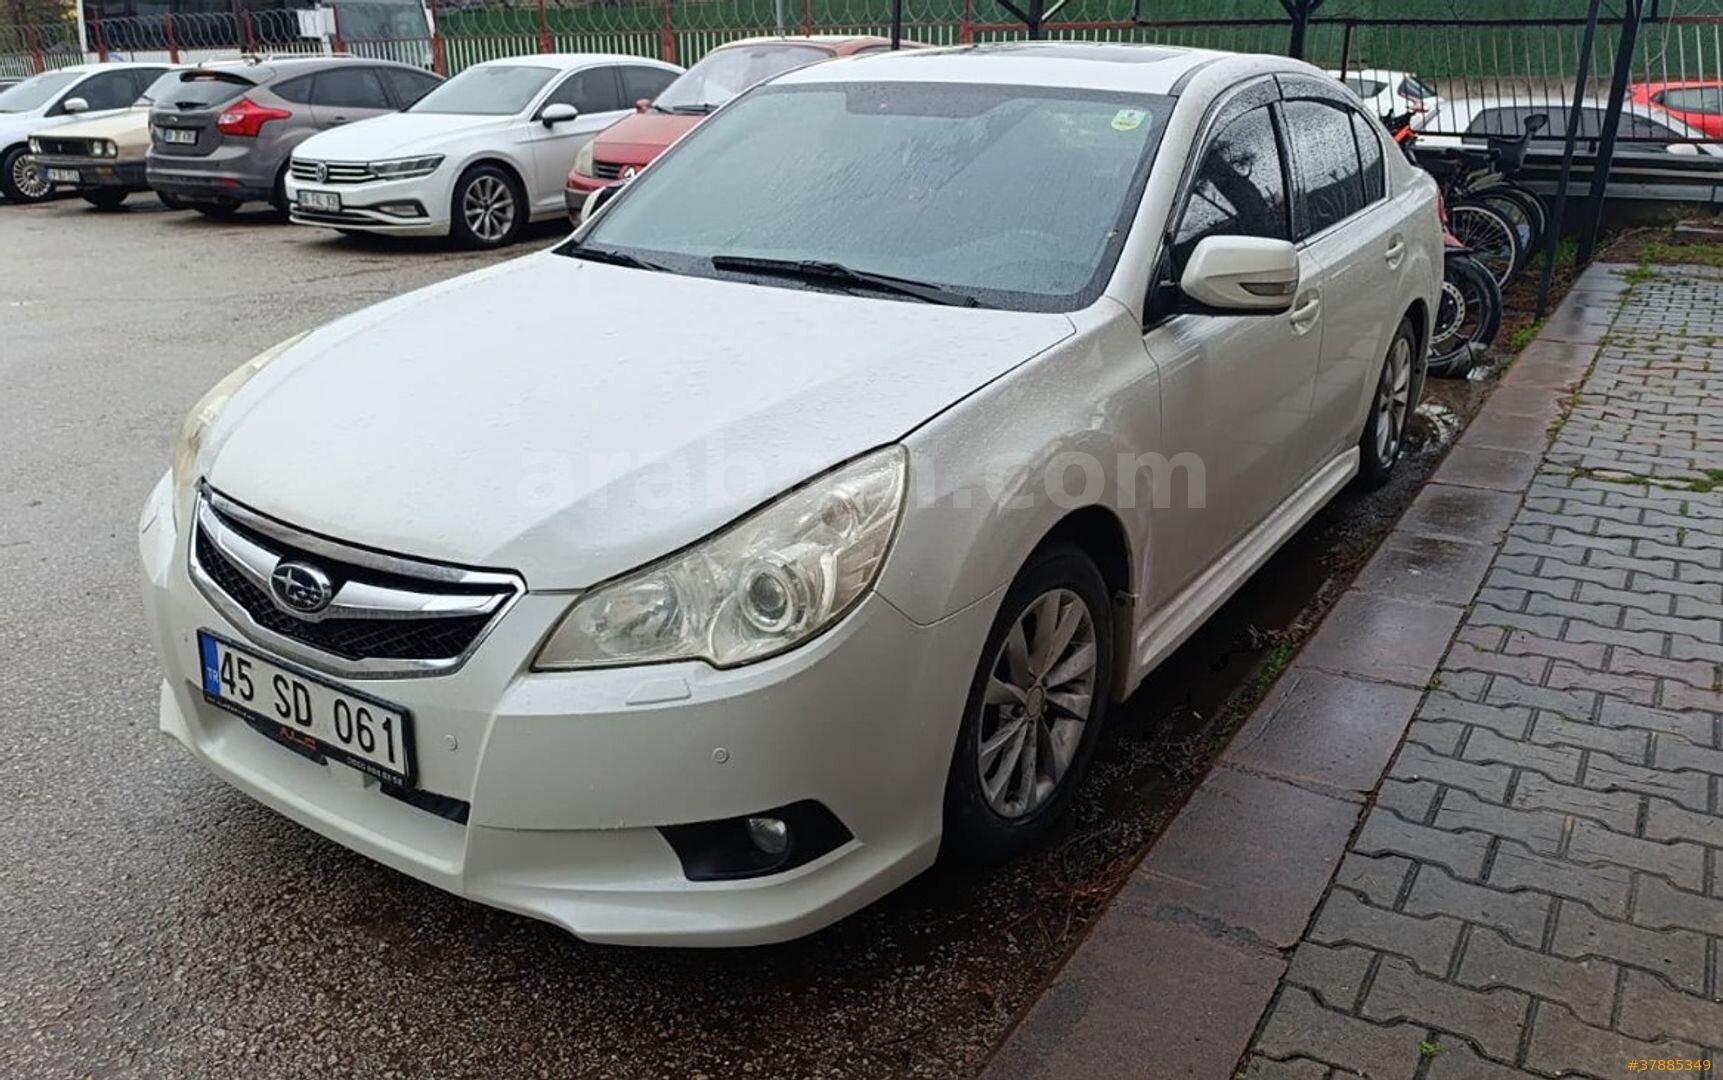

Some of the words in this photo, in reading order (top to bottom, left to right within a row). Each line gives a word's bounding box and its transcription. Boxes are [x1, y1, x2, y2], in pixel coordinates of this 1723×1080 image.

[206, 667, 219, 683] TR
[221, 652, 255, 701] 45
[273, 674, 312, 727] SD
[334, 699, 396, 763] 061
